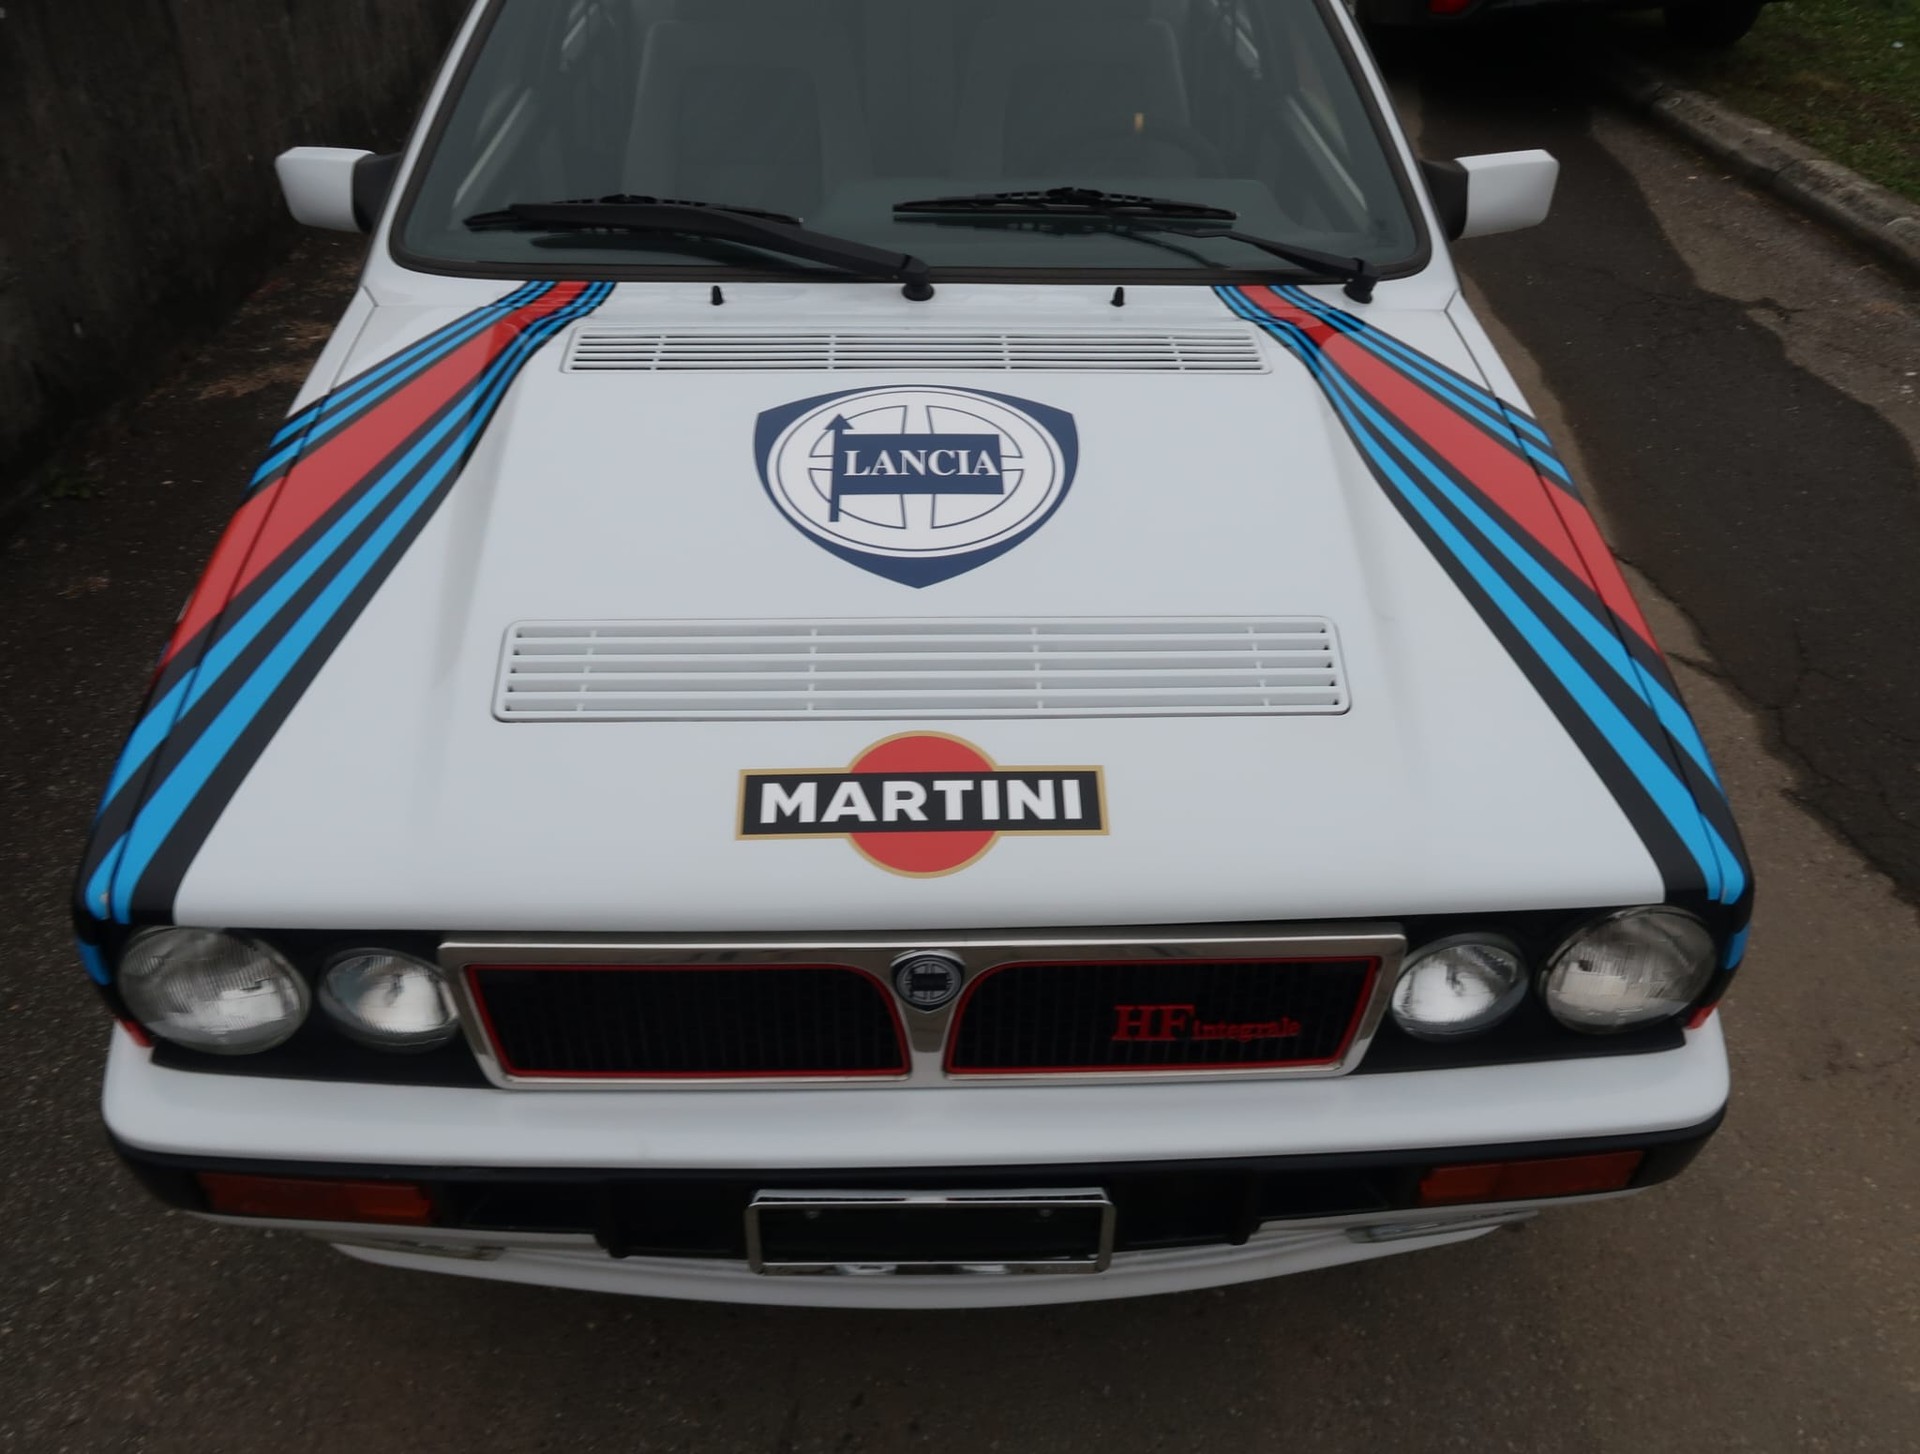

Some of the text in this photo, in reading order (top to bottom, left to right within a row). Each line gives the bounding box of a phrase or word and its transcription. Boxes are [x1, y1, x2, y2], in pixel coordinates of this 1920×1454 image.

[843, 449, 1000, 476] LANCIA
[760, 779, 1083, 823] MARTINI
[1111, 1004, 1194, 1041] HF
